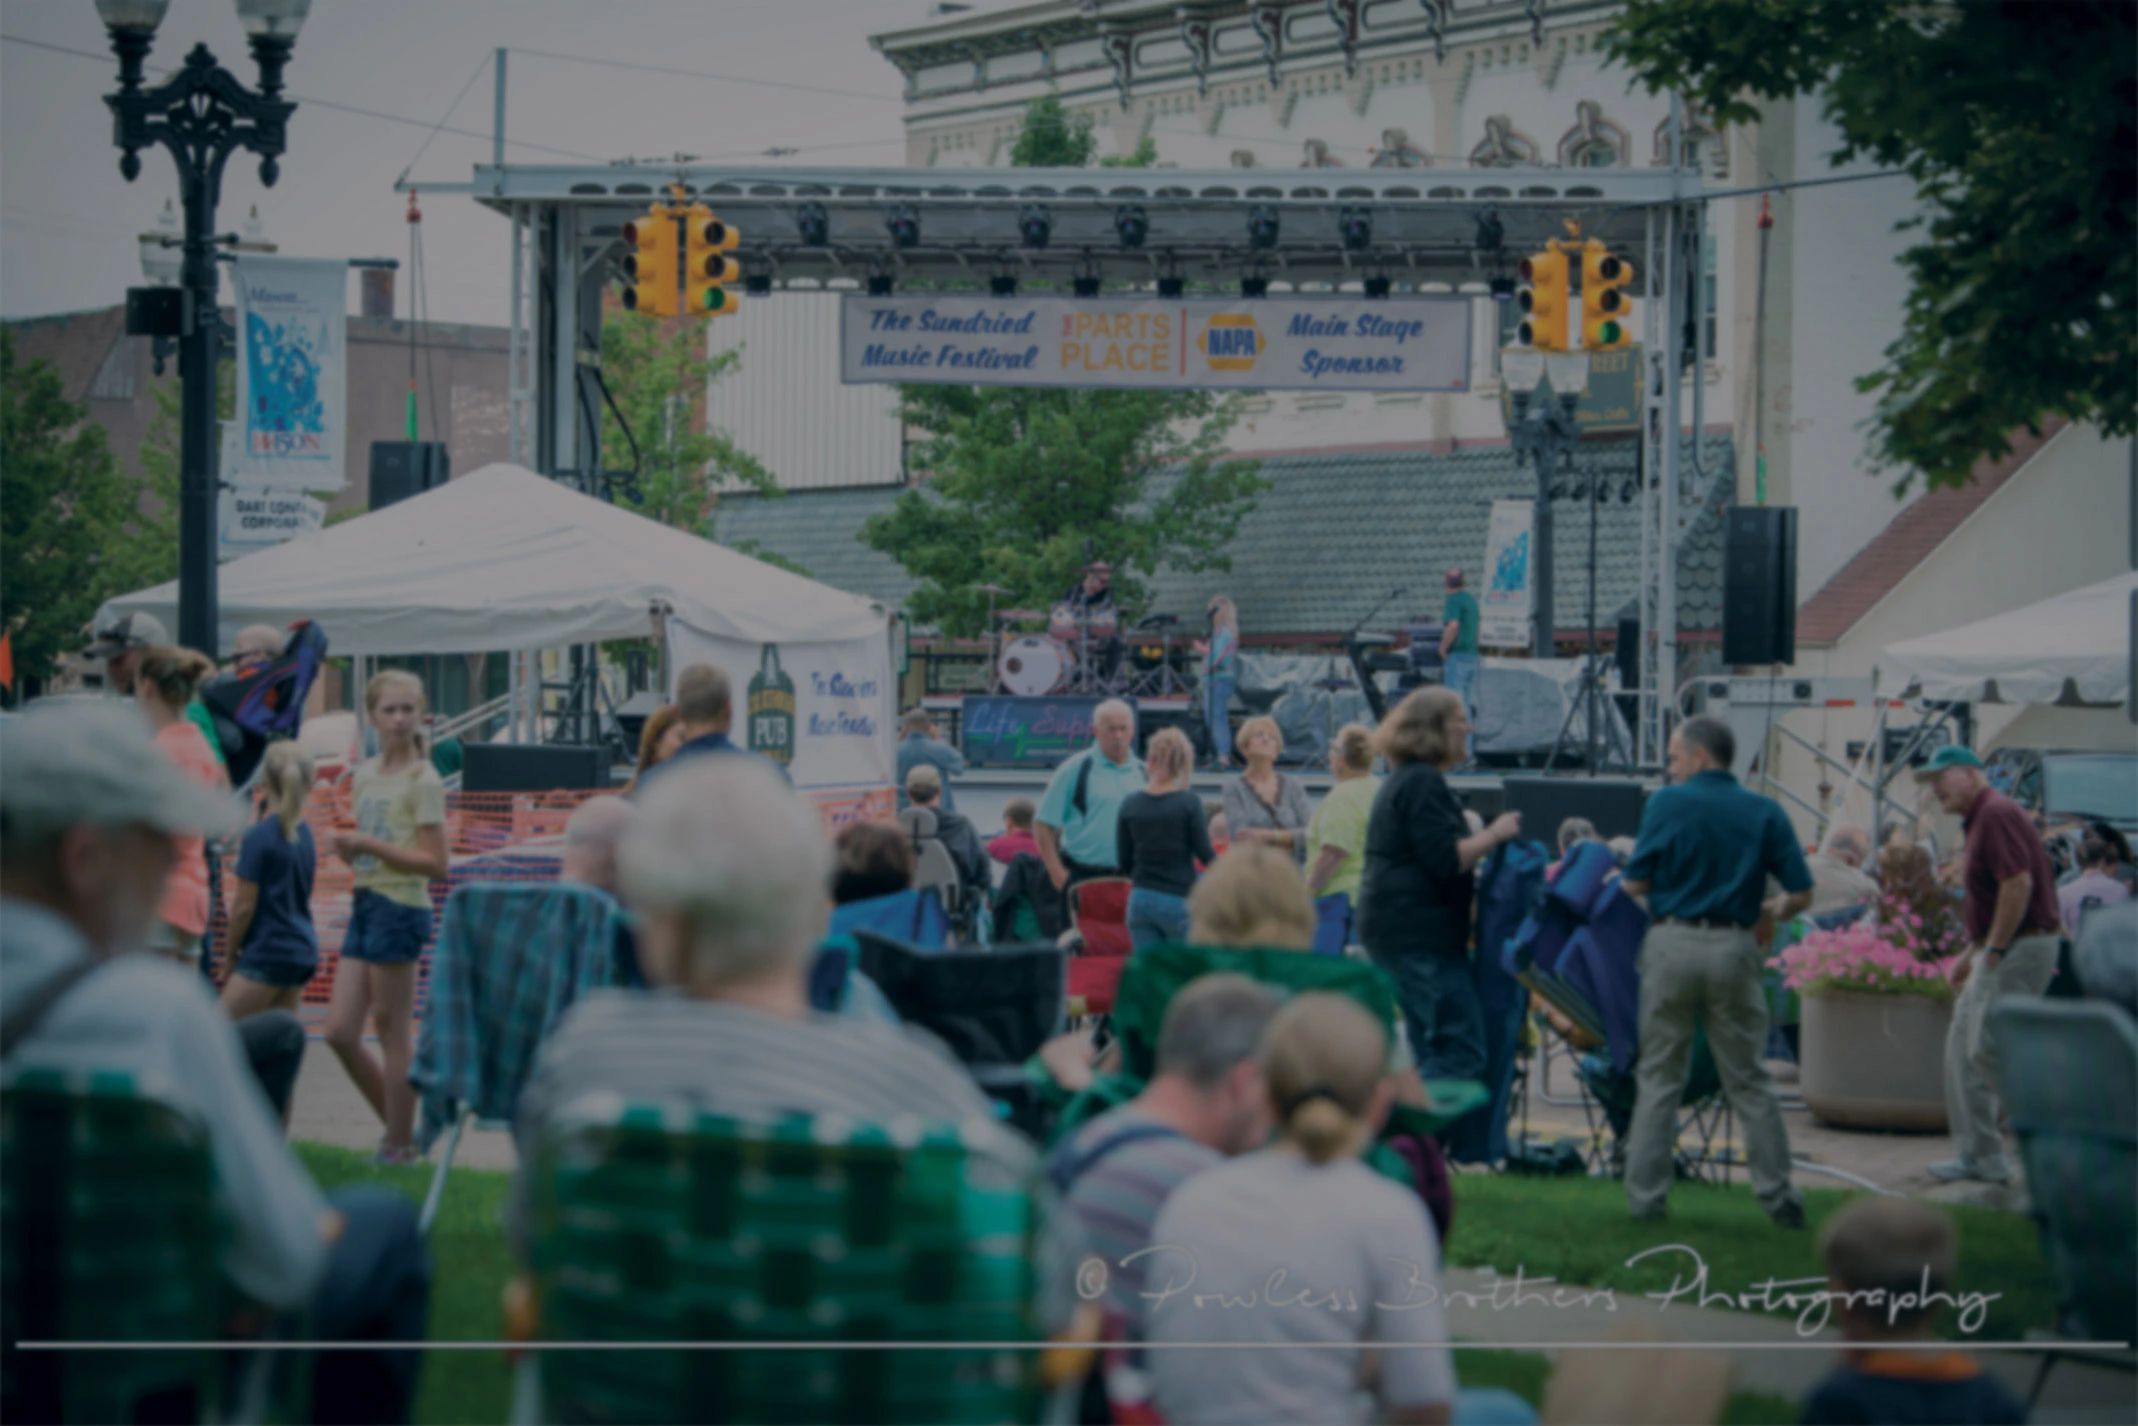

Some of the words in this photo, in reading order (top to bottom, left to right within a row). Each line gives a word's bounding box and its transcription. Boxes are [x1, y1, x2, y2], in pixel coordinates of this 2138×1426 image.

[870, 309, 914, 331] The
[917, 309, 1037, 335] Sundried
[1076, 312, 1170, 340] PARTS
[1286, 312, 1349, 338] Main
[1353, 312, 1424, 345] Stage
[861, 344, 931, 367] Music
[935, 344, 1040, 370] Festival
[1061, 342, 1170, 372] PLACE
[1207, 328, 1257, 357] NAPA
[1298, 348, 1406, 379] Sponsor
[755, 717, 788, 746] PUB
[966, 702, 1019, 744] Life
[1031, 703, 1094, 748] Supp
